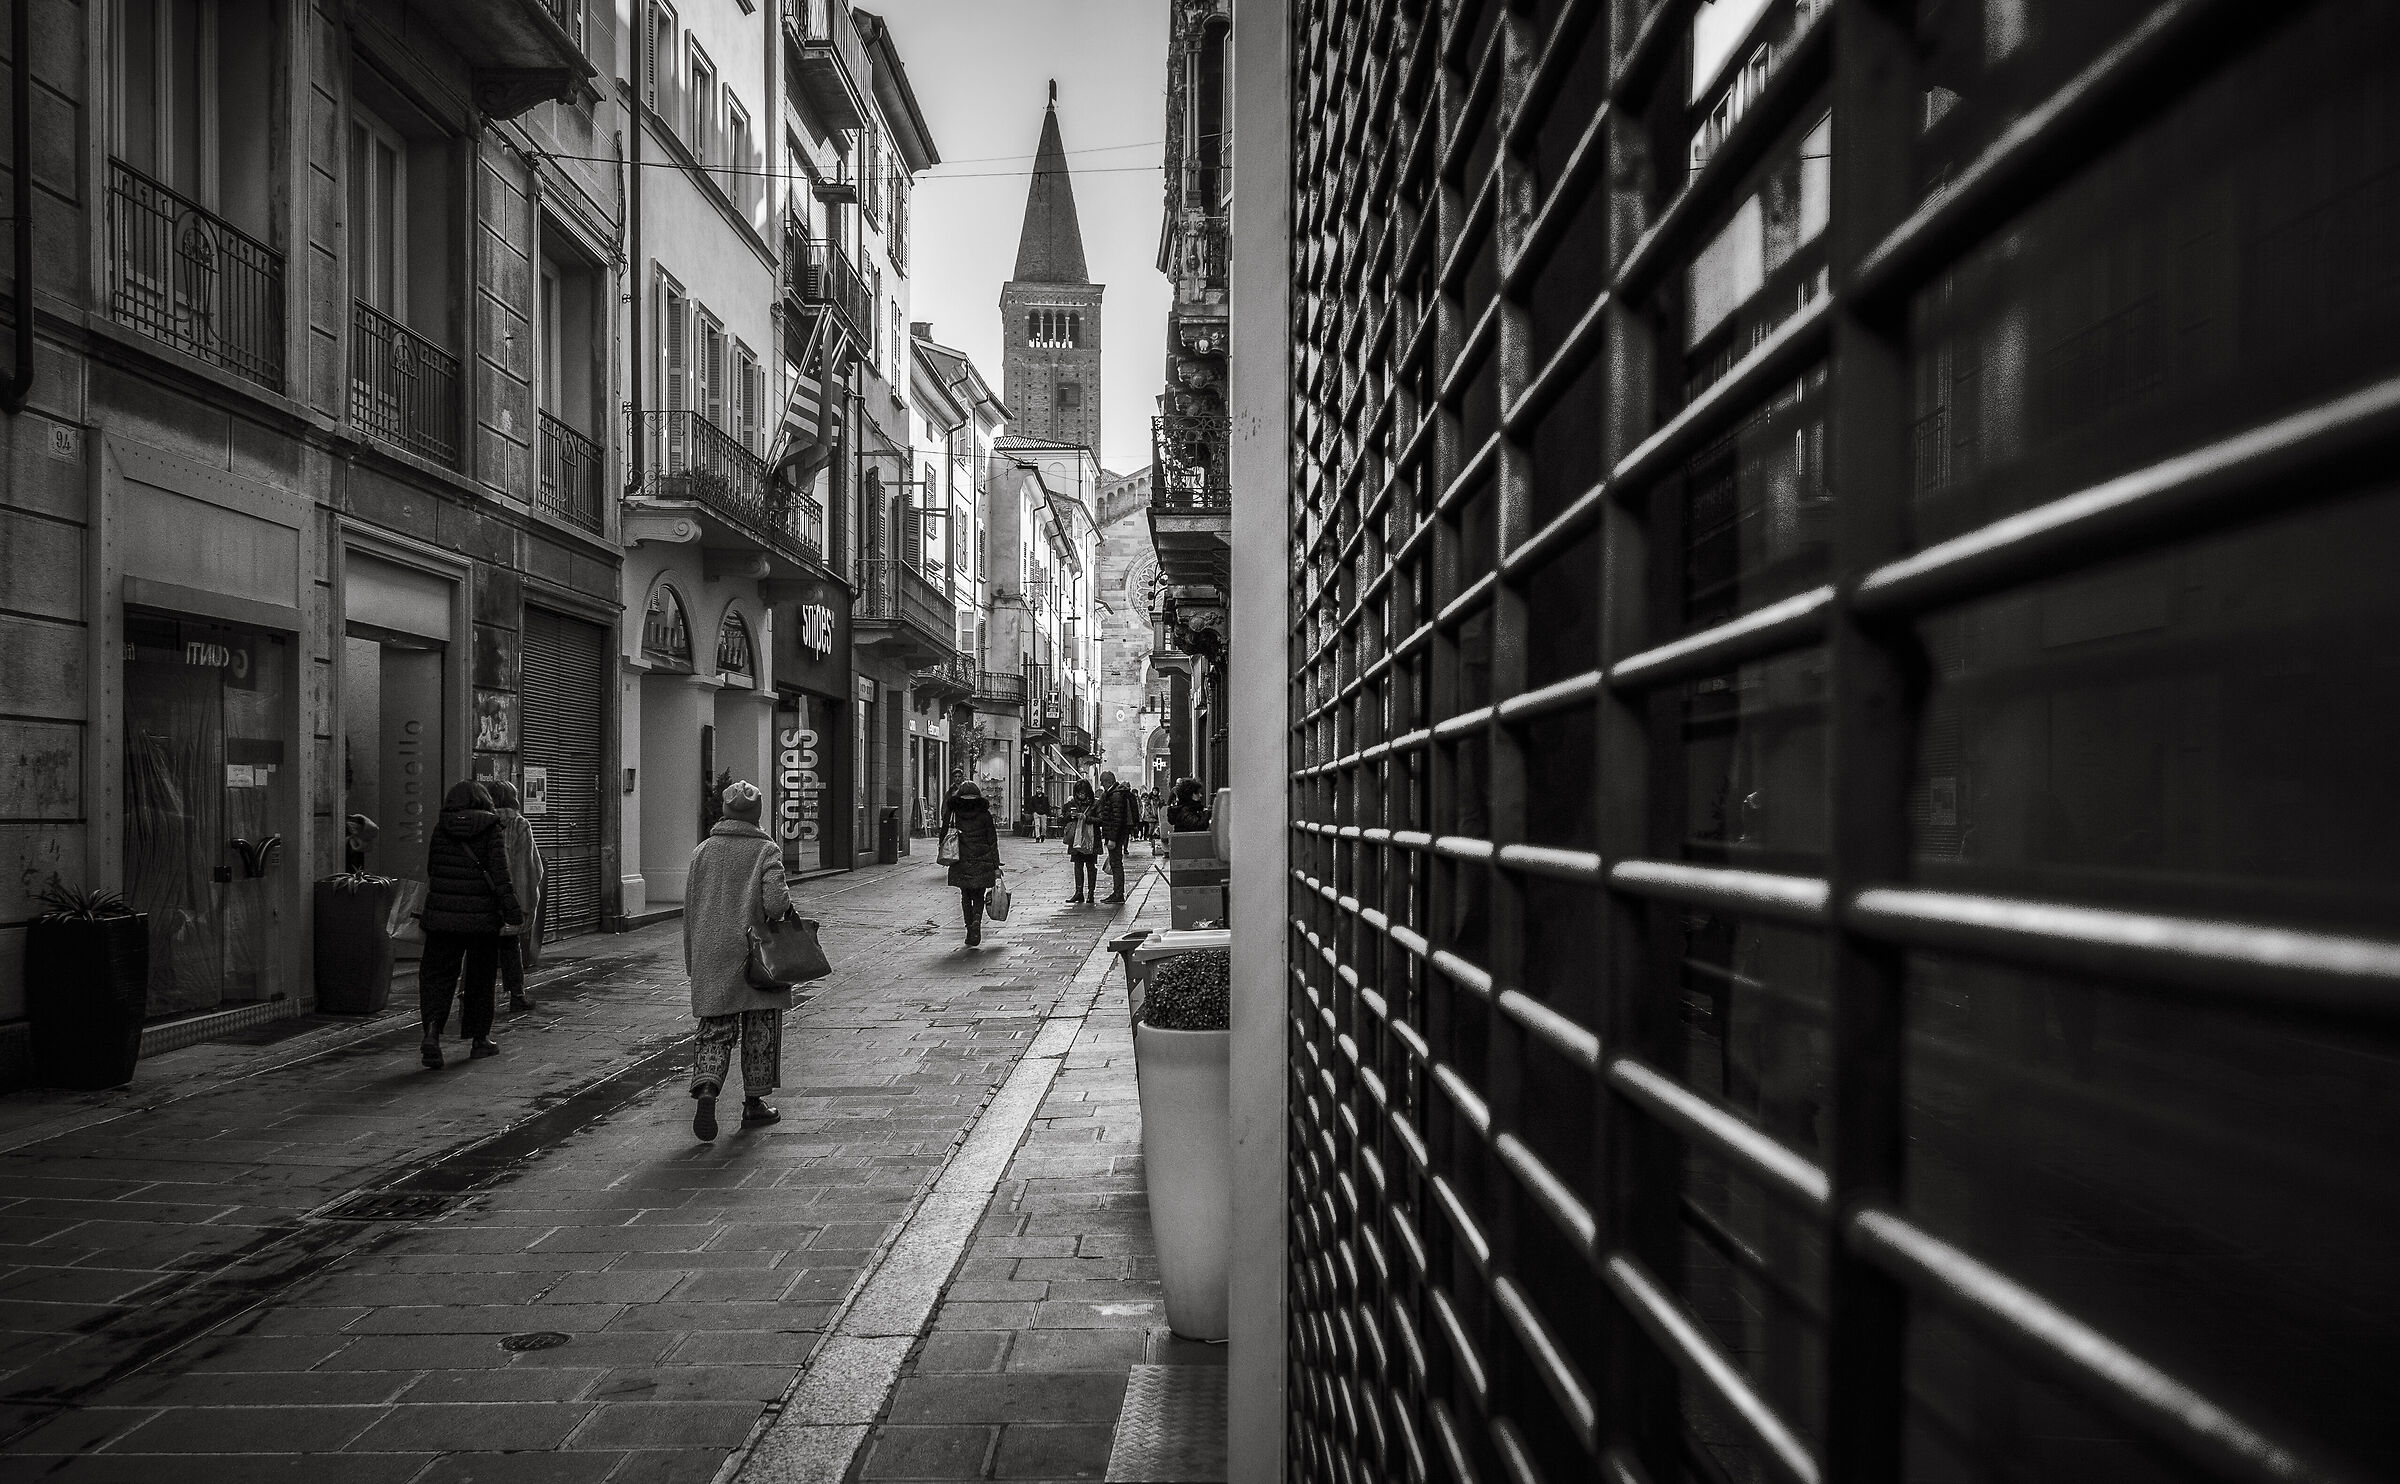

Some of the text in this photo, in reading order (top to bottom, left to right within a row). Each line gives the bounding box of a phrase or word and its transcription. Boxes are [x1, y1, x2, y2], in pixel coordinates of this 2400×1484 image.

[56, 430, 72, 451] 94
[802, 604, 832, 661] snipes
[399, 720, 423, 843] Monello
[780, 729, 827, 840] snipes
